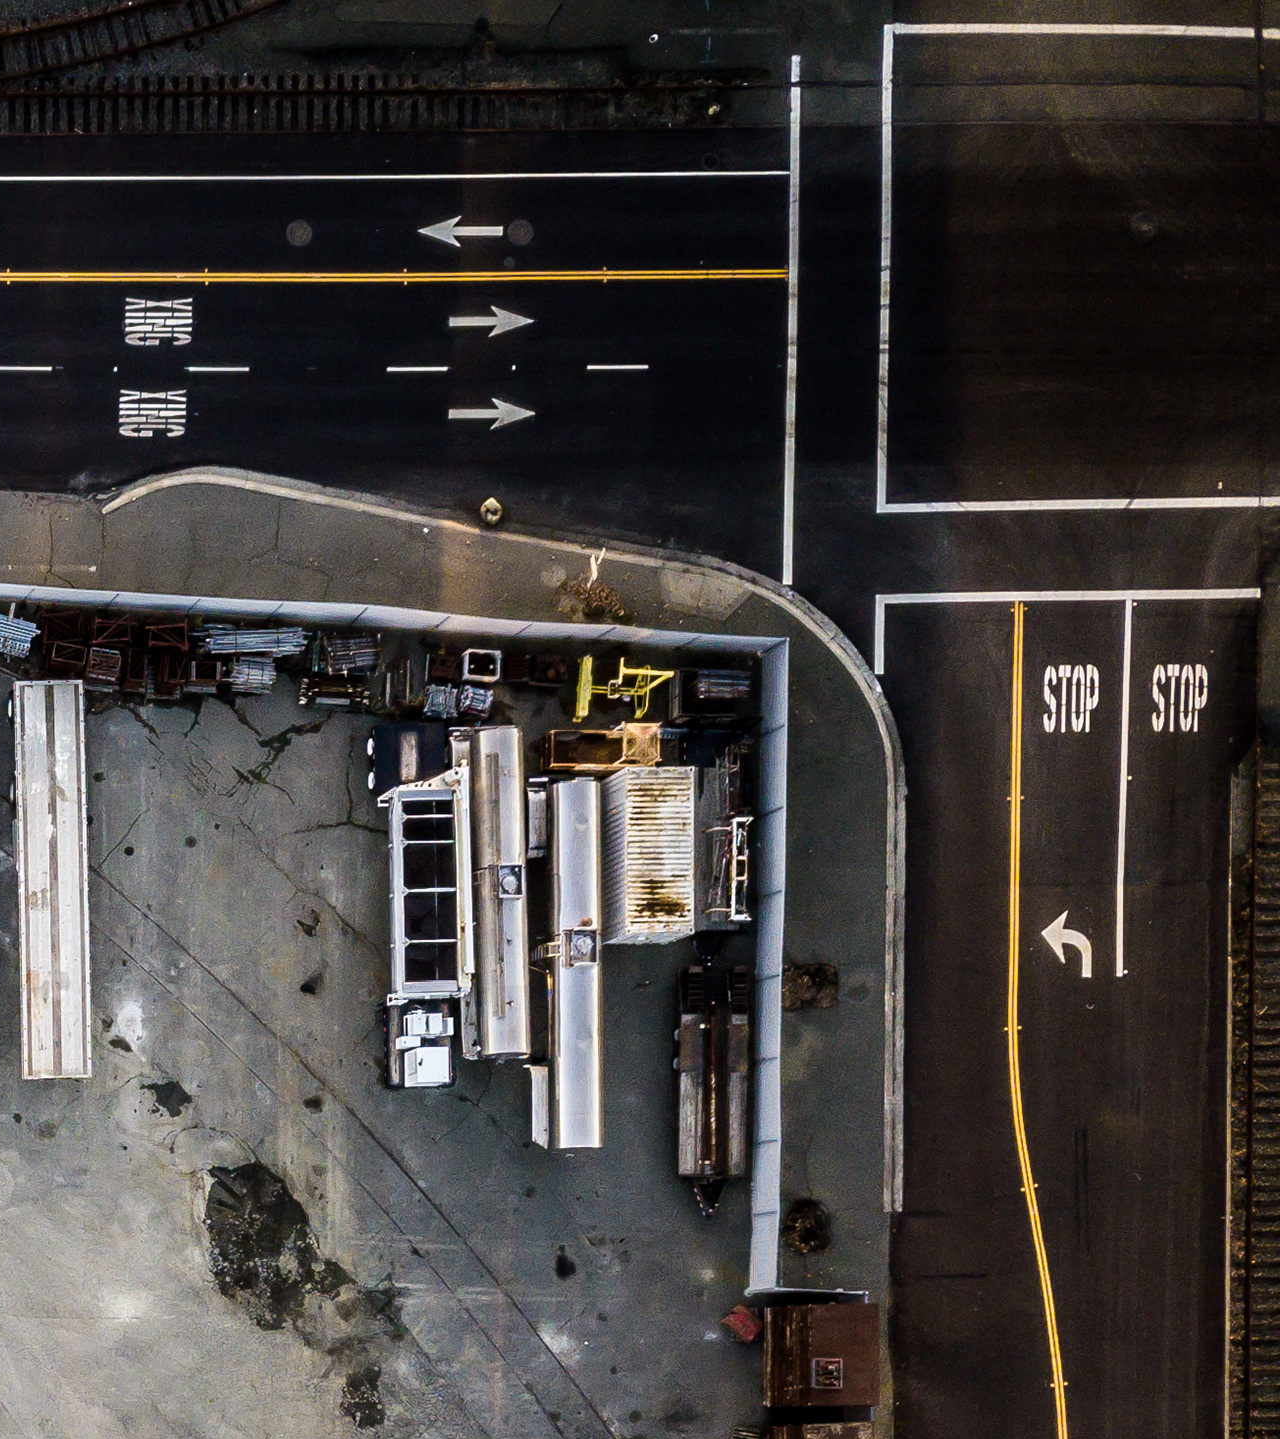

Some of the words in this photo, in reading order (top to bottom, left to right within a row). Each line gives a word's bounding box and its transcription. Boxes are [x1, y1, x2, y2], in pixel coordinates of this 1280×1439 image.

[125, 298, 193, 346] XING
[119, 389, 187, 437] XING
[1043, 664, 1100, 734] STOP
[1152, 664, 1208, 733] STOP
